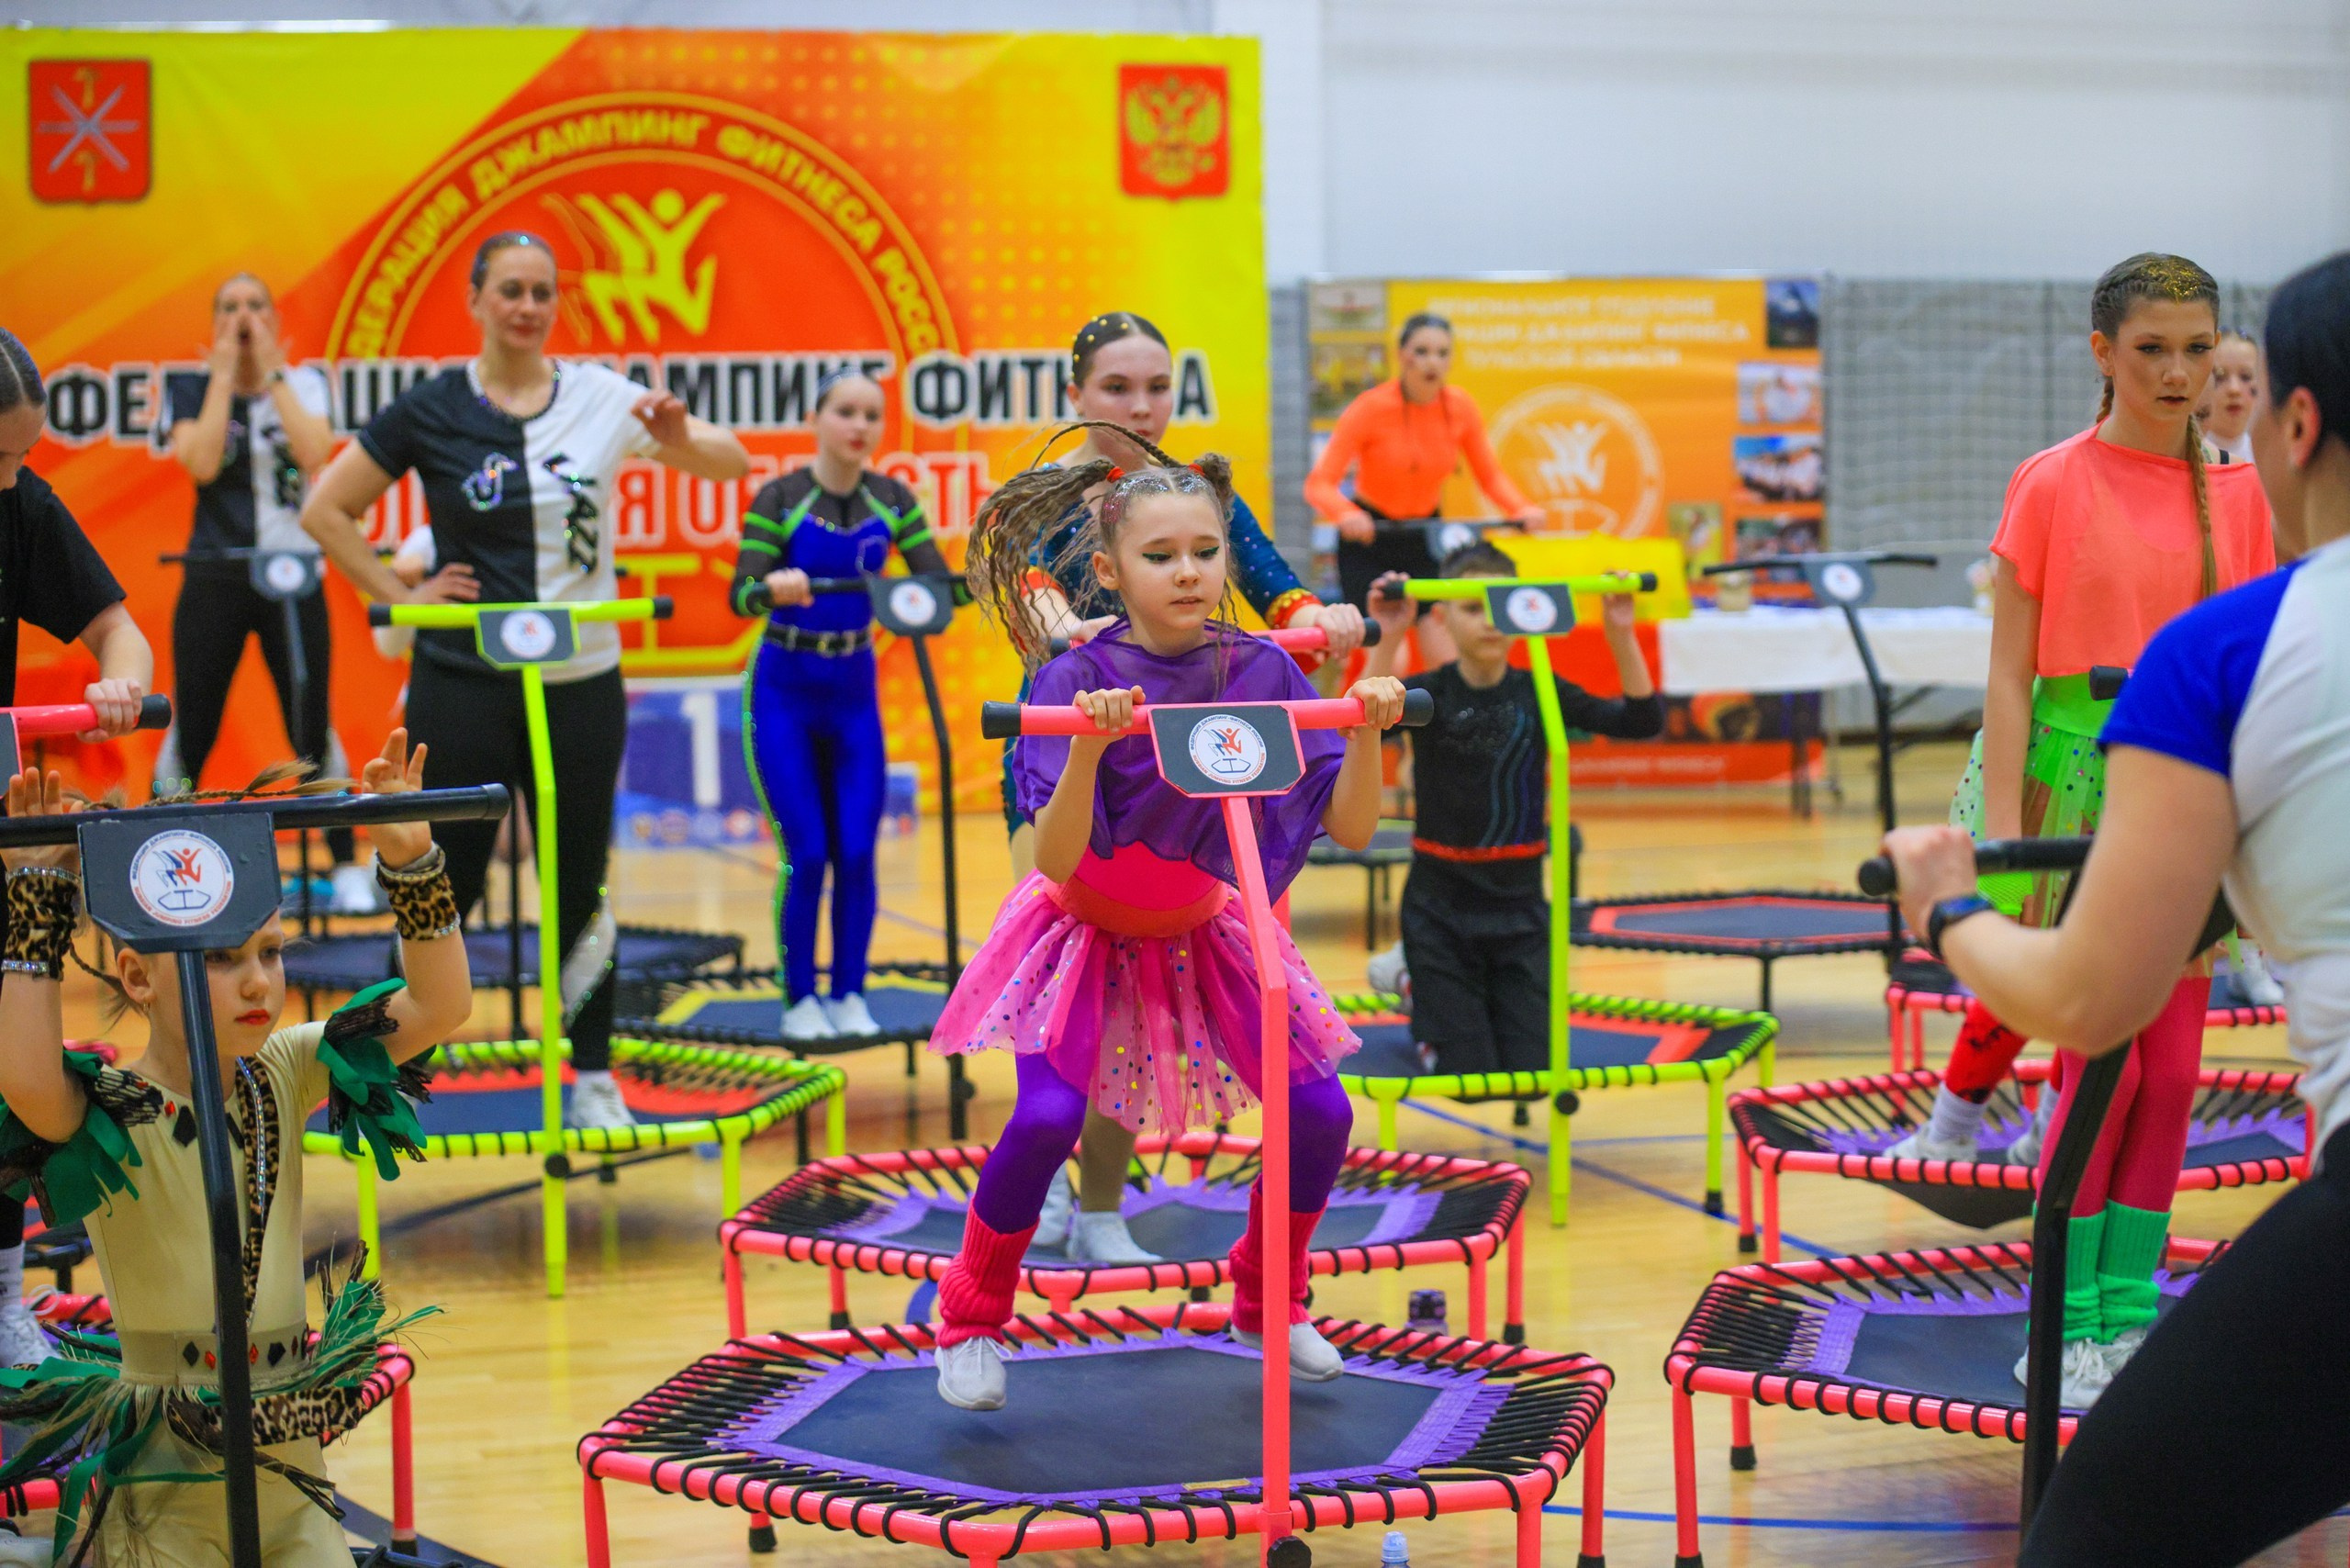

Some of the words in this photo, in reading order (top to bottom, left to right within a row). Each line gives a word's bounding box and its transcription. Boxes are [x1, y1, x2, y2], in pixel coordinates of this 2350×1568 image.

[346, 182, 469, 360] ДЕРАЦИЯ
[470, 110, 711, 204] ДЖАМПИНГ
[715, 125, 883, 252] ФИТНЕСА
[873, 246, 939, 357] РОСС
[914, 357, 1210, 419] ФИТА
